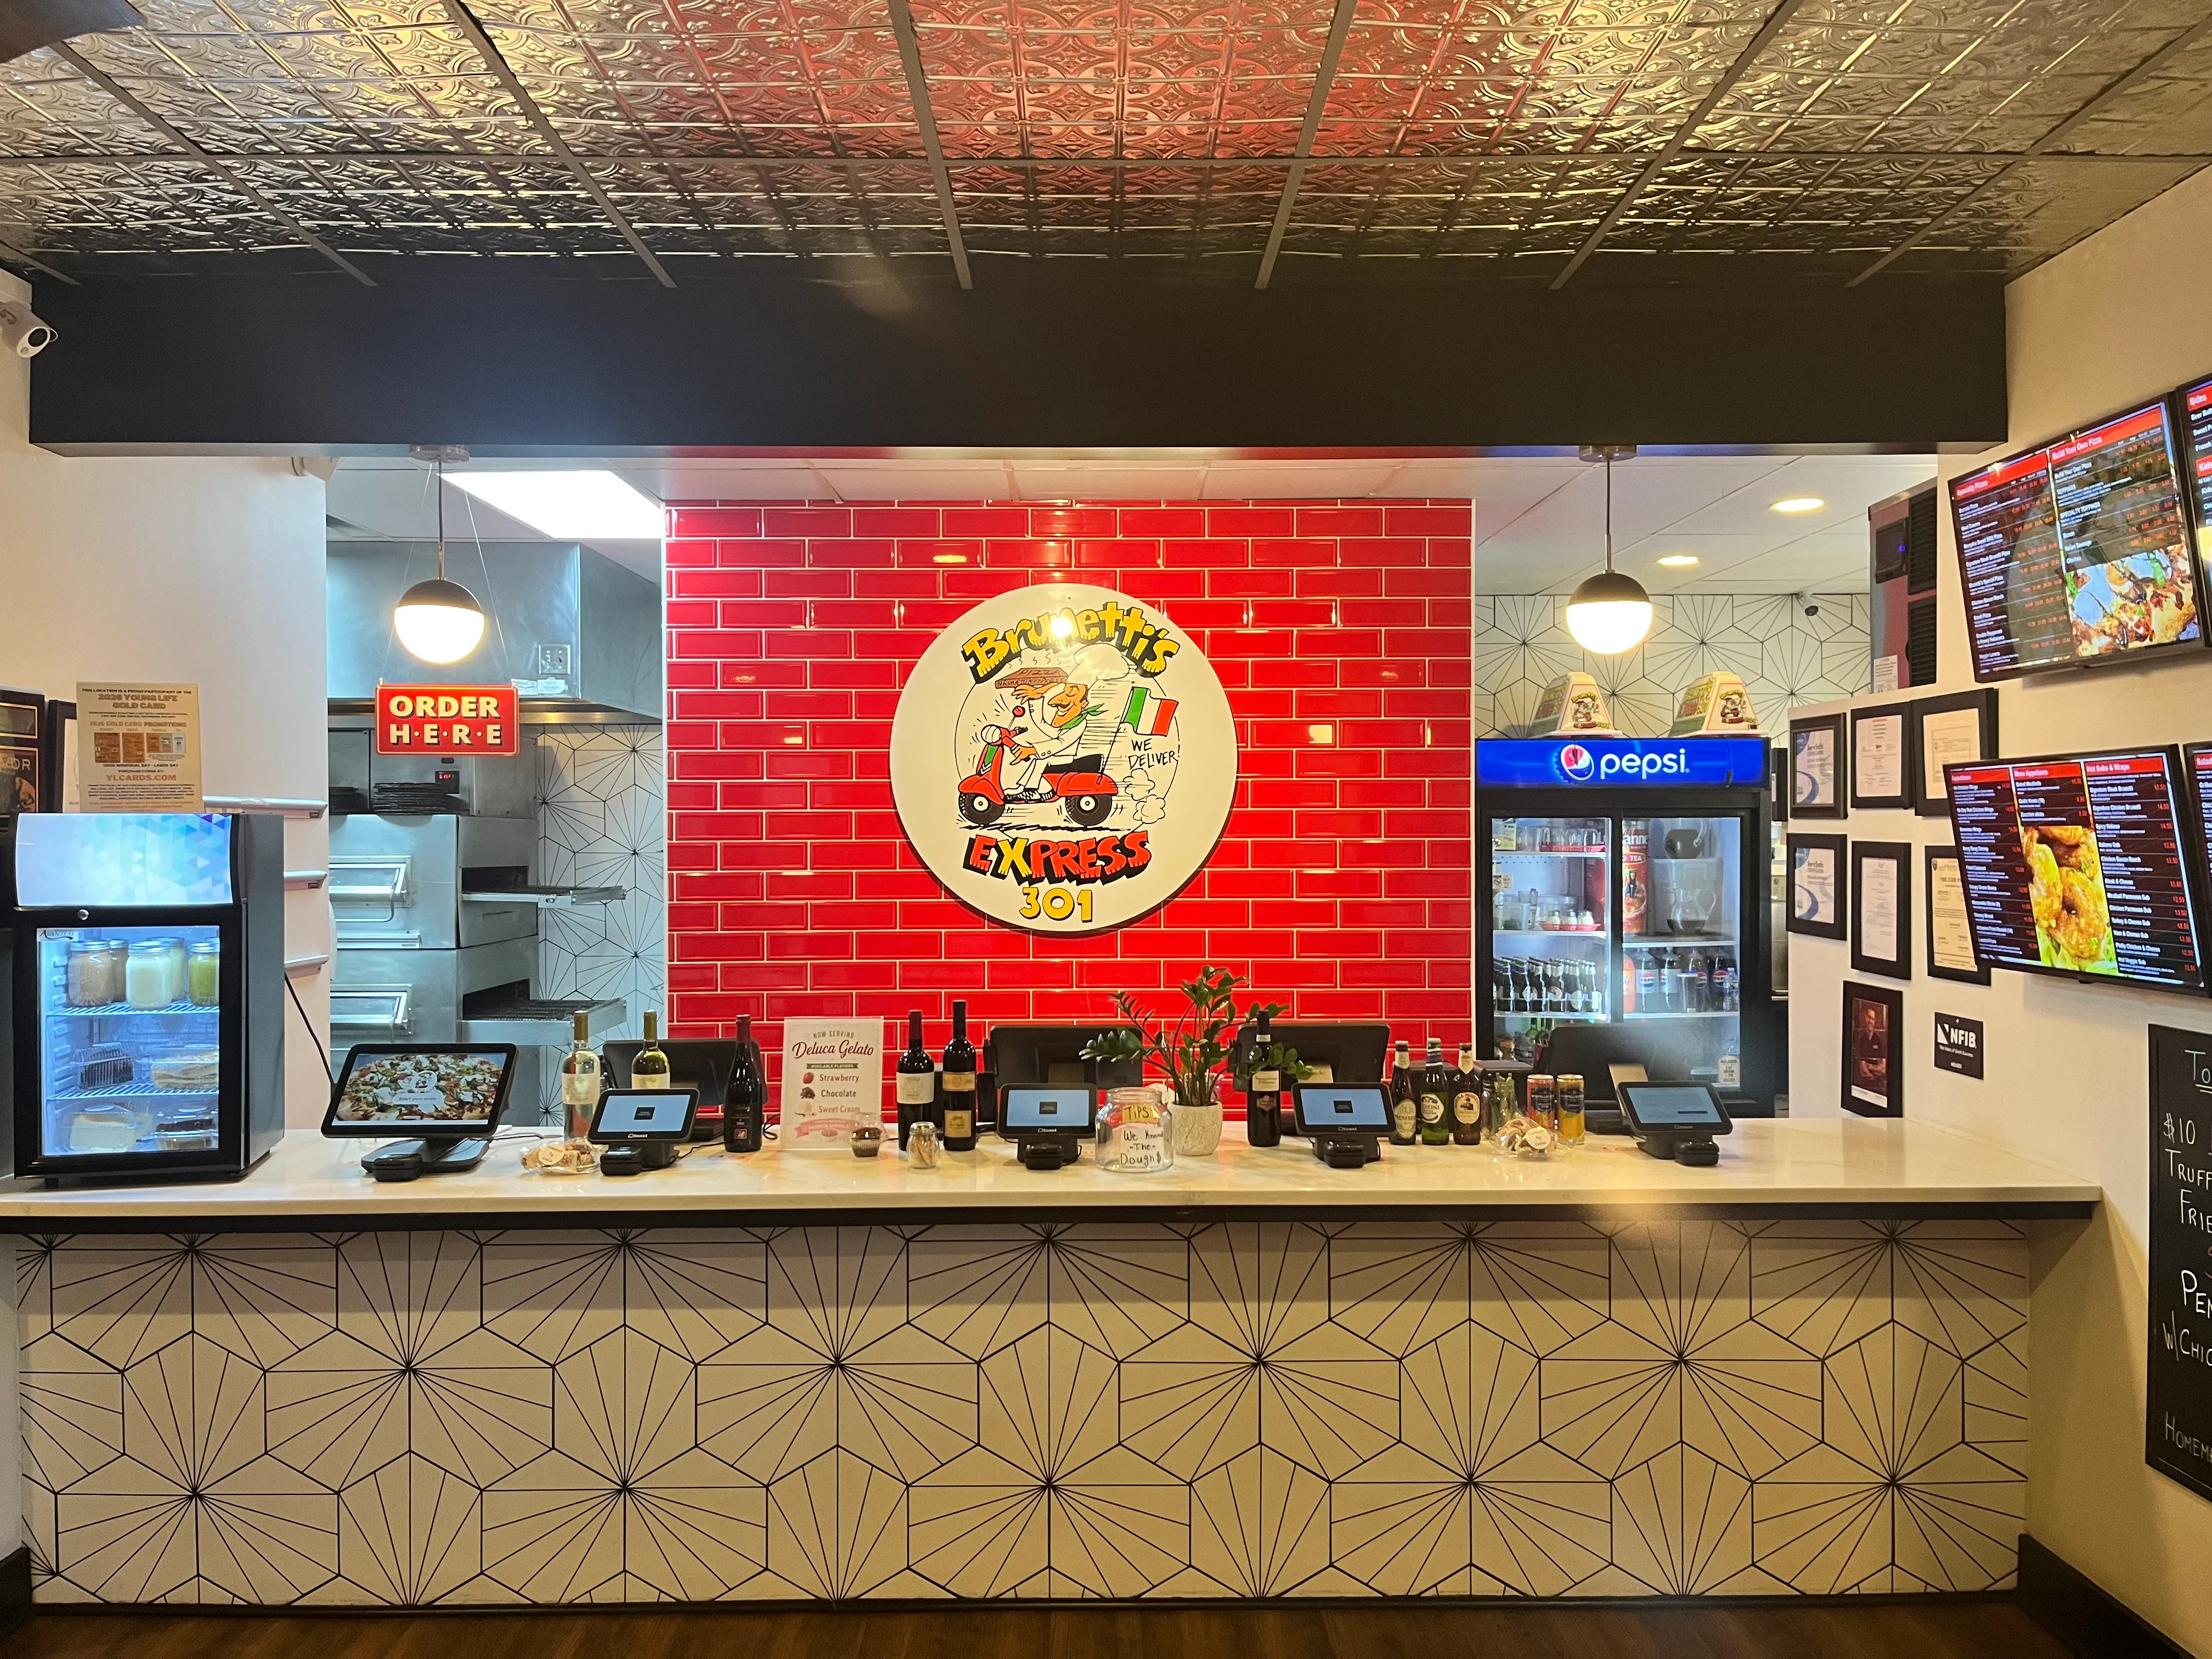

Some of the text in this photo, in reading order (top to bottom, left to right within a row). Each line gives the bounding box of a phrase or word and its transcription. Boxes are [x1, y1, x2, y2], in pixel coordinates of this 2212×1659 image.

[390, 695, 501, 719] ORDER
[1131, 738, 1153, 751] WE
[1600, 748, 1686, 780] pepsi
[963, 830, 1153, 887] EXPRESS
[1019, 887, 1093, 923] 301
[813, 1030, 855, 1039] NOW SERVING
[1950, 1028, 1976, 1048] NFIB
[792, 1039, 874, 1059] Deluca Gelato
[819, 1074, 859, 1083] Strawberry
[821, 1089, 856, 1098] Chocolate
[1124, 1130, 1138, 1141] We
[2163, 1113, 2196, 1144] $10
